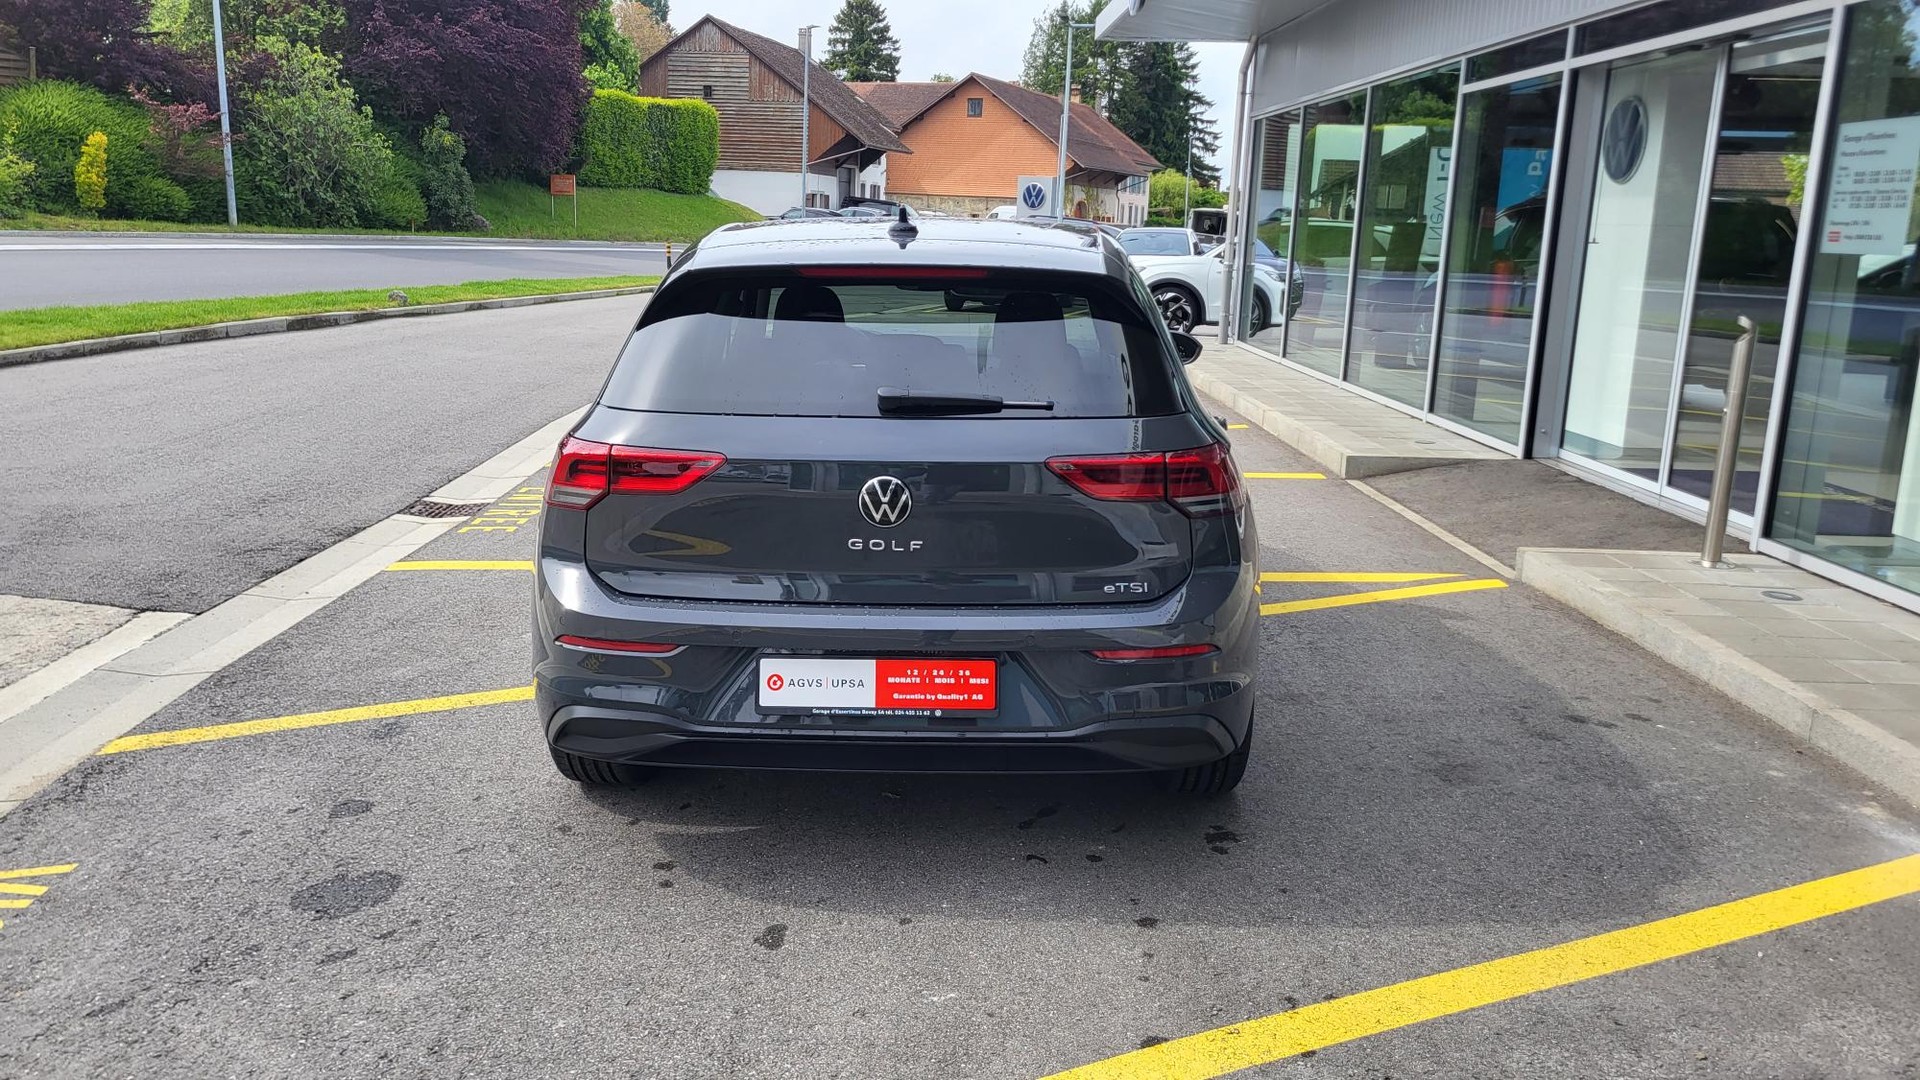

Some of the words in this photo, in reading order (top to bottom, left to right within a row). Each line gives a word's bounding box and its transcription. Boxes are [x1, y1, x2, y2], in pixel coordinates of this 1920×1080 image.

[848, 538, 924, 552] GOLF
[1103, 582, 1149, 594] eTSI
[788, 678, 823, 688] AGVS
[832, 679, 865, 688] UPSA
[926, 693, 936, 702] by
[937, 693, 969, 702] Quality1
